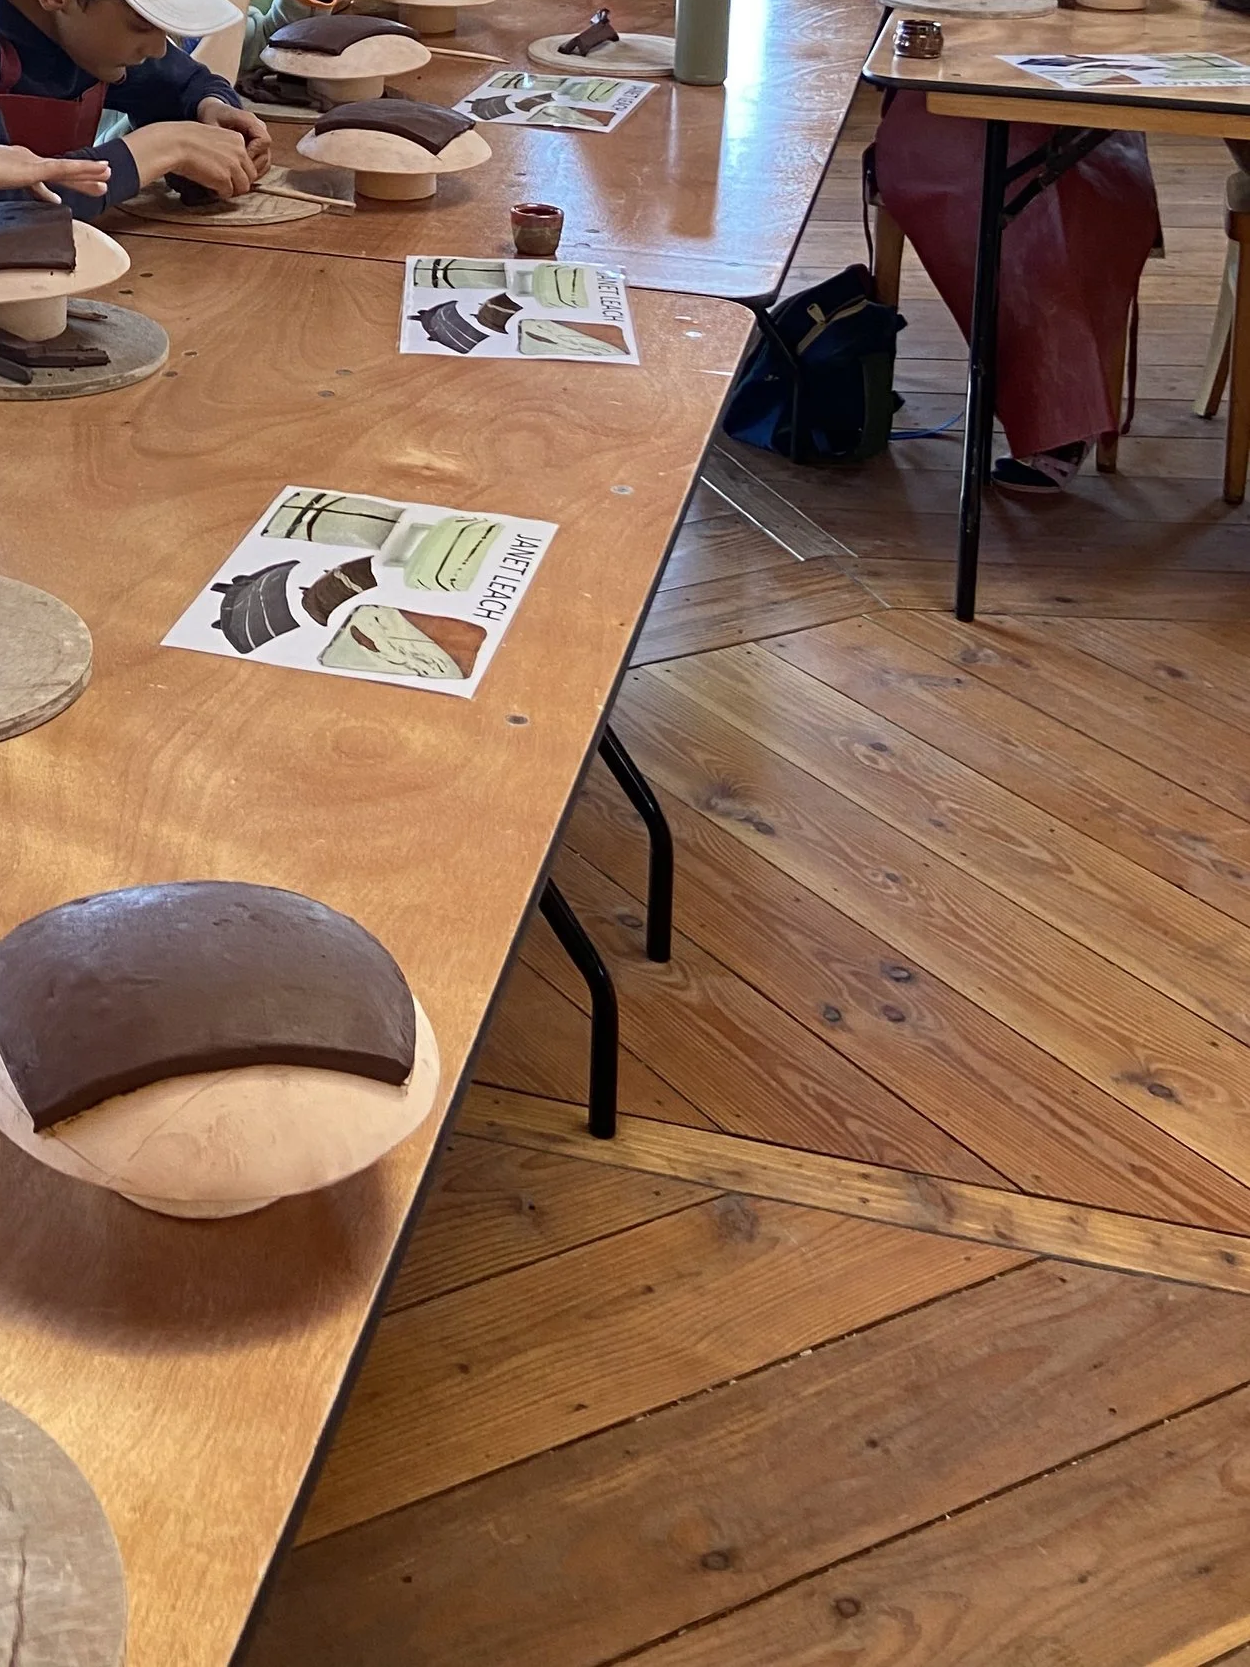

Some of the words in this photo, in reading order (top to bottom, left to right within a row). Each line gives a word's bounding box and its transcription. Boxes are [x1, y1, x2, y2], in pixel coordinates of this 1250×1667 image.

[600, 296, 625, 322] LEACH
[499, 534, 542, 576] JANET
[472, 575, 521, 621] LEACH
